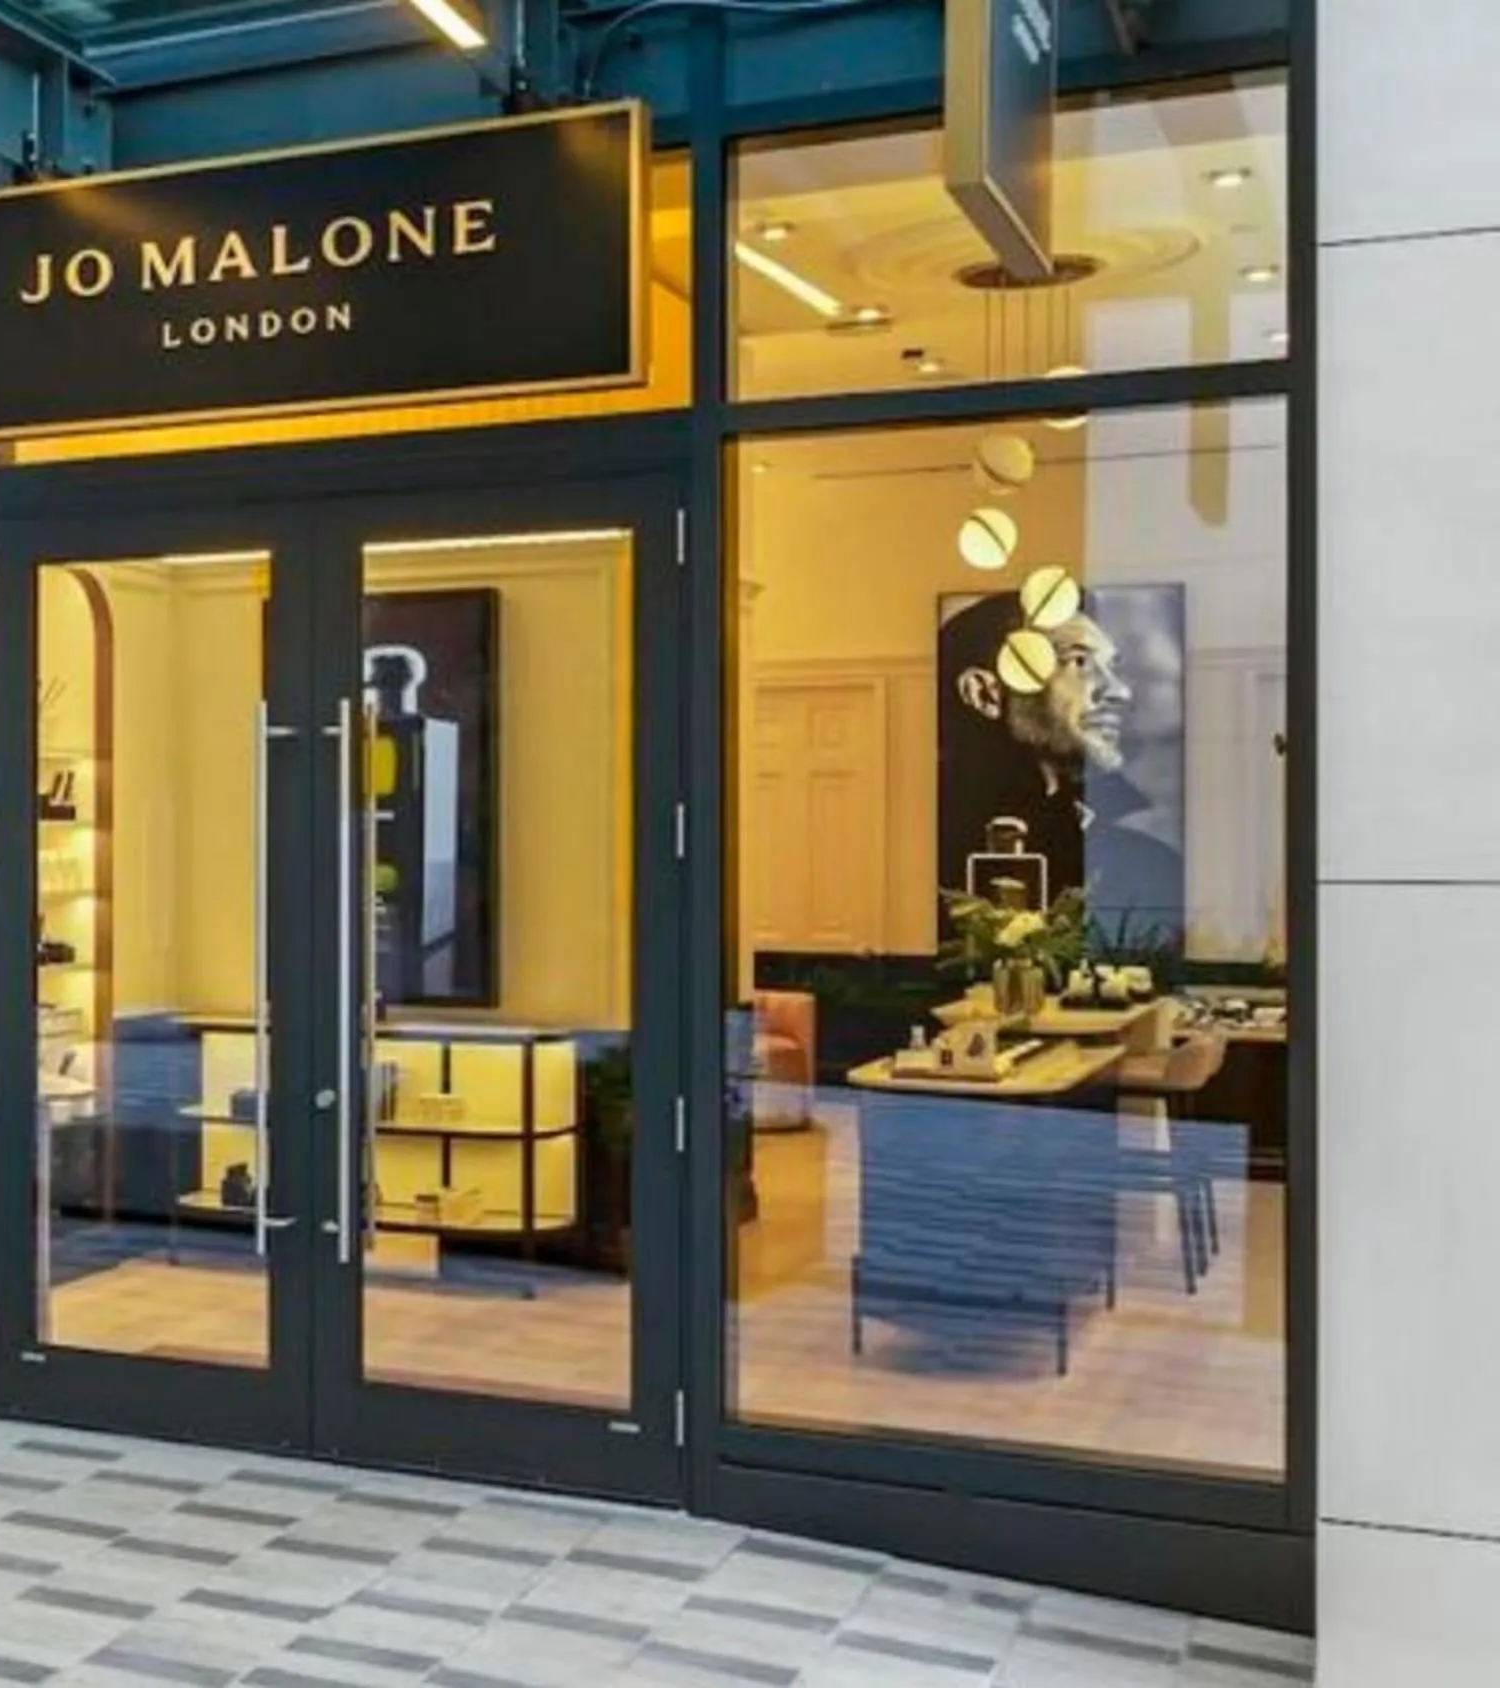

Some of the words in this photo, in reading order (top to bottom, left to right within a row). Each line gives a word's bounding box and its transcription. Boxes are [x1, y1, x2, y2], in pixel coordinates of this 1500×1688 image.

[20, 249, 113, 304] JO
[141, 199, 497, 291] MALONE
[161, 303, 352, 349] LONDON
